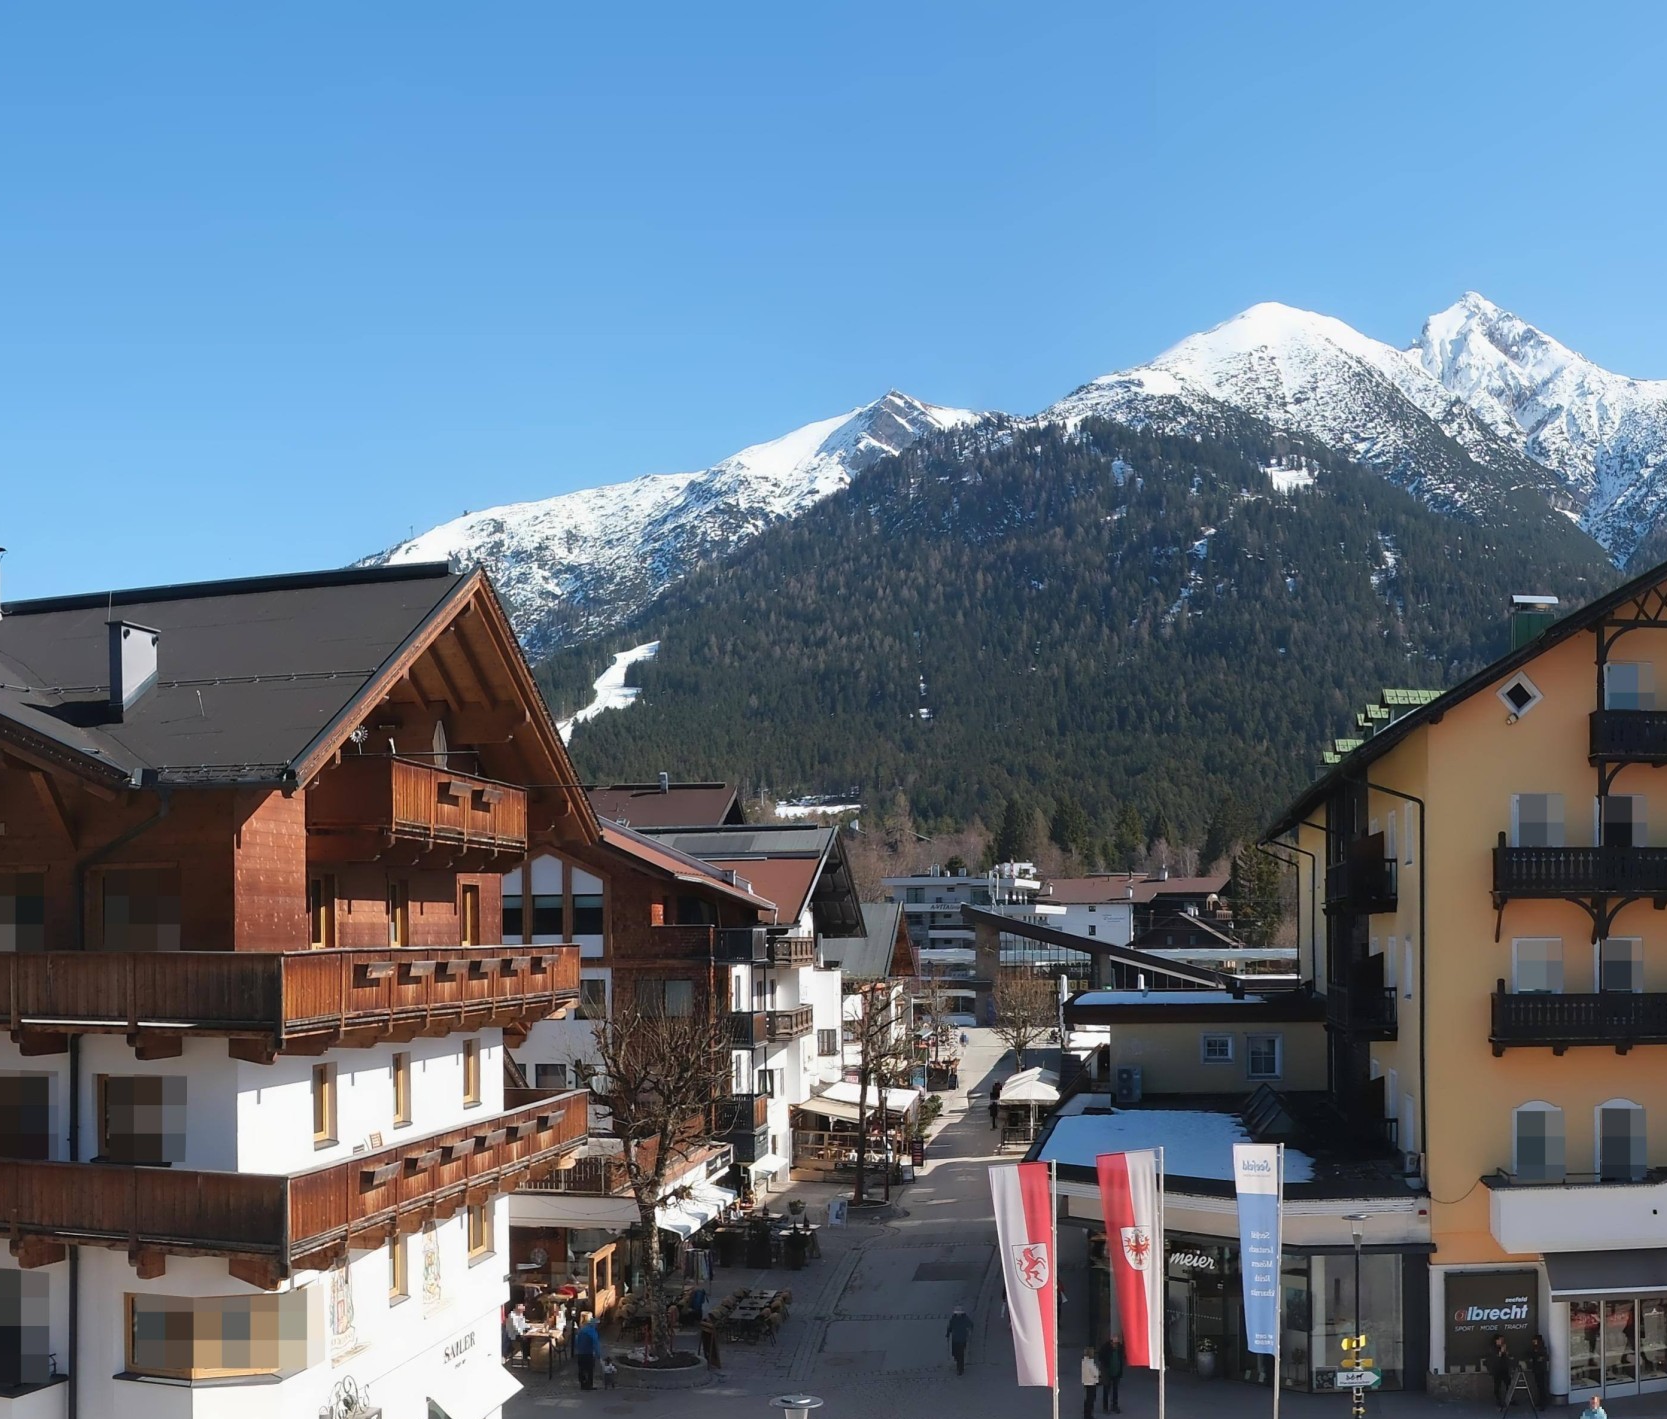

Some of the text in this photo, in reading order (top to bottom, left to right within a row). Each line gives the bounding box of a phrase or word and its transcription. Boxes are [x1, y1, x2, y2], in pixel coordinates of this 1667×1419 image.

[1169, 1250, 1215, 1270] meier
[1454, 1304, 1528, 1322] albrecht
[444, 1331, 476, 1364] SAILER
